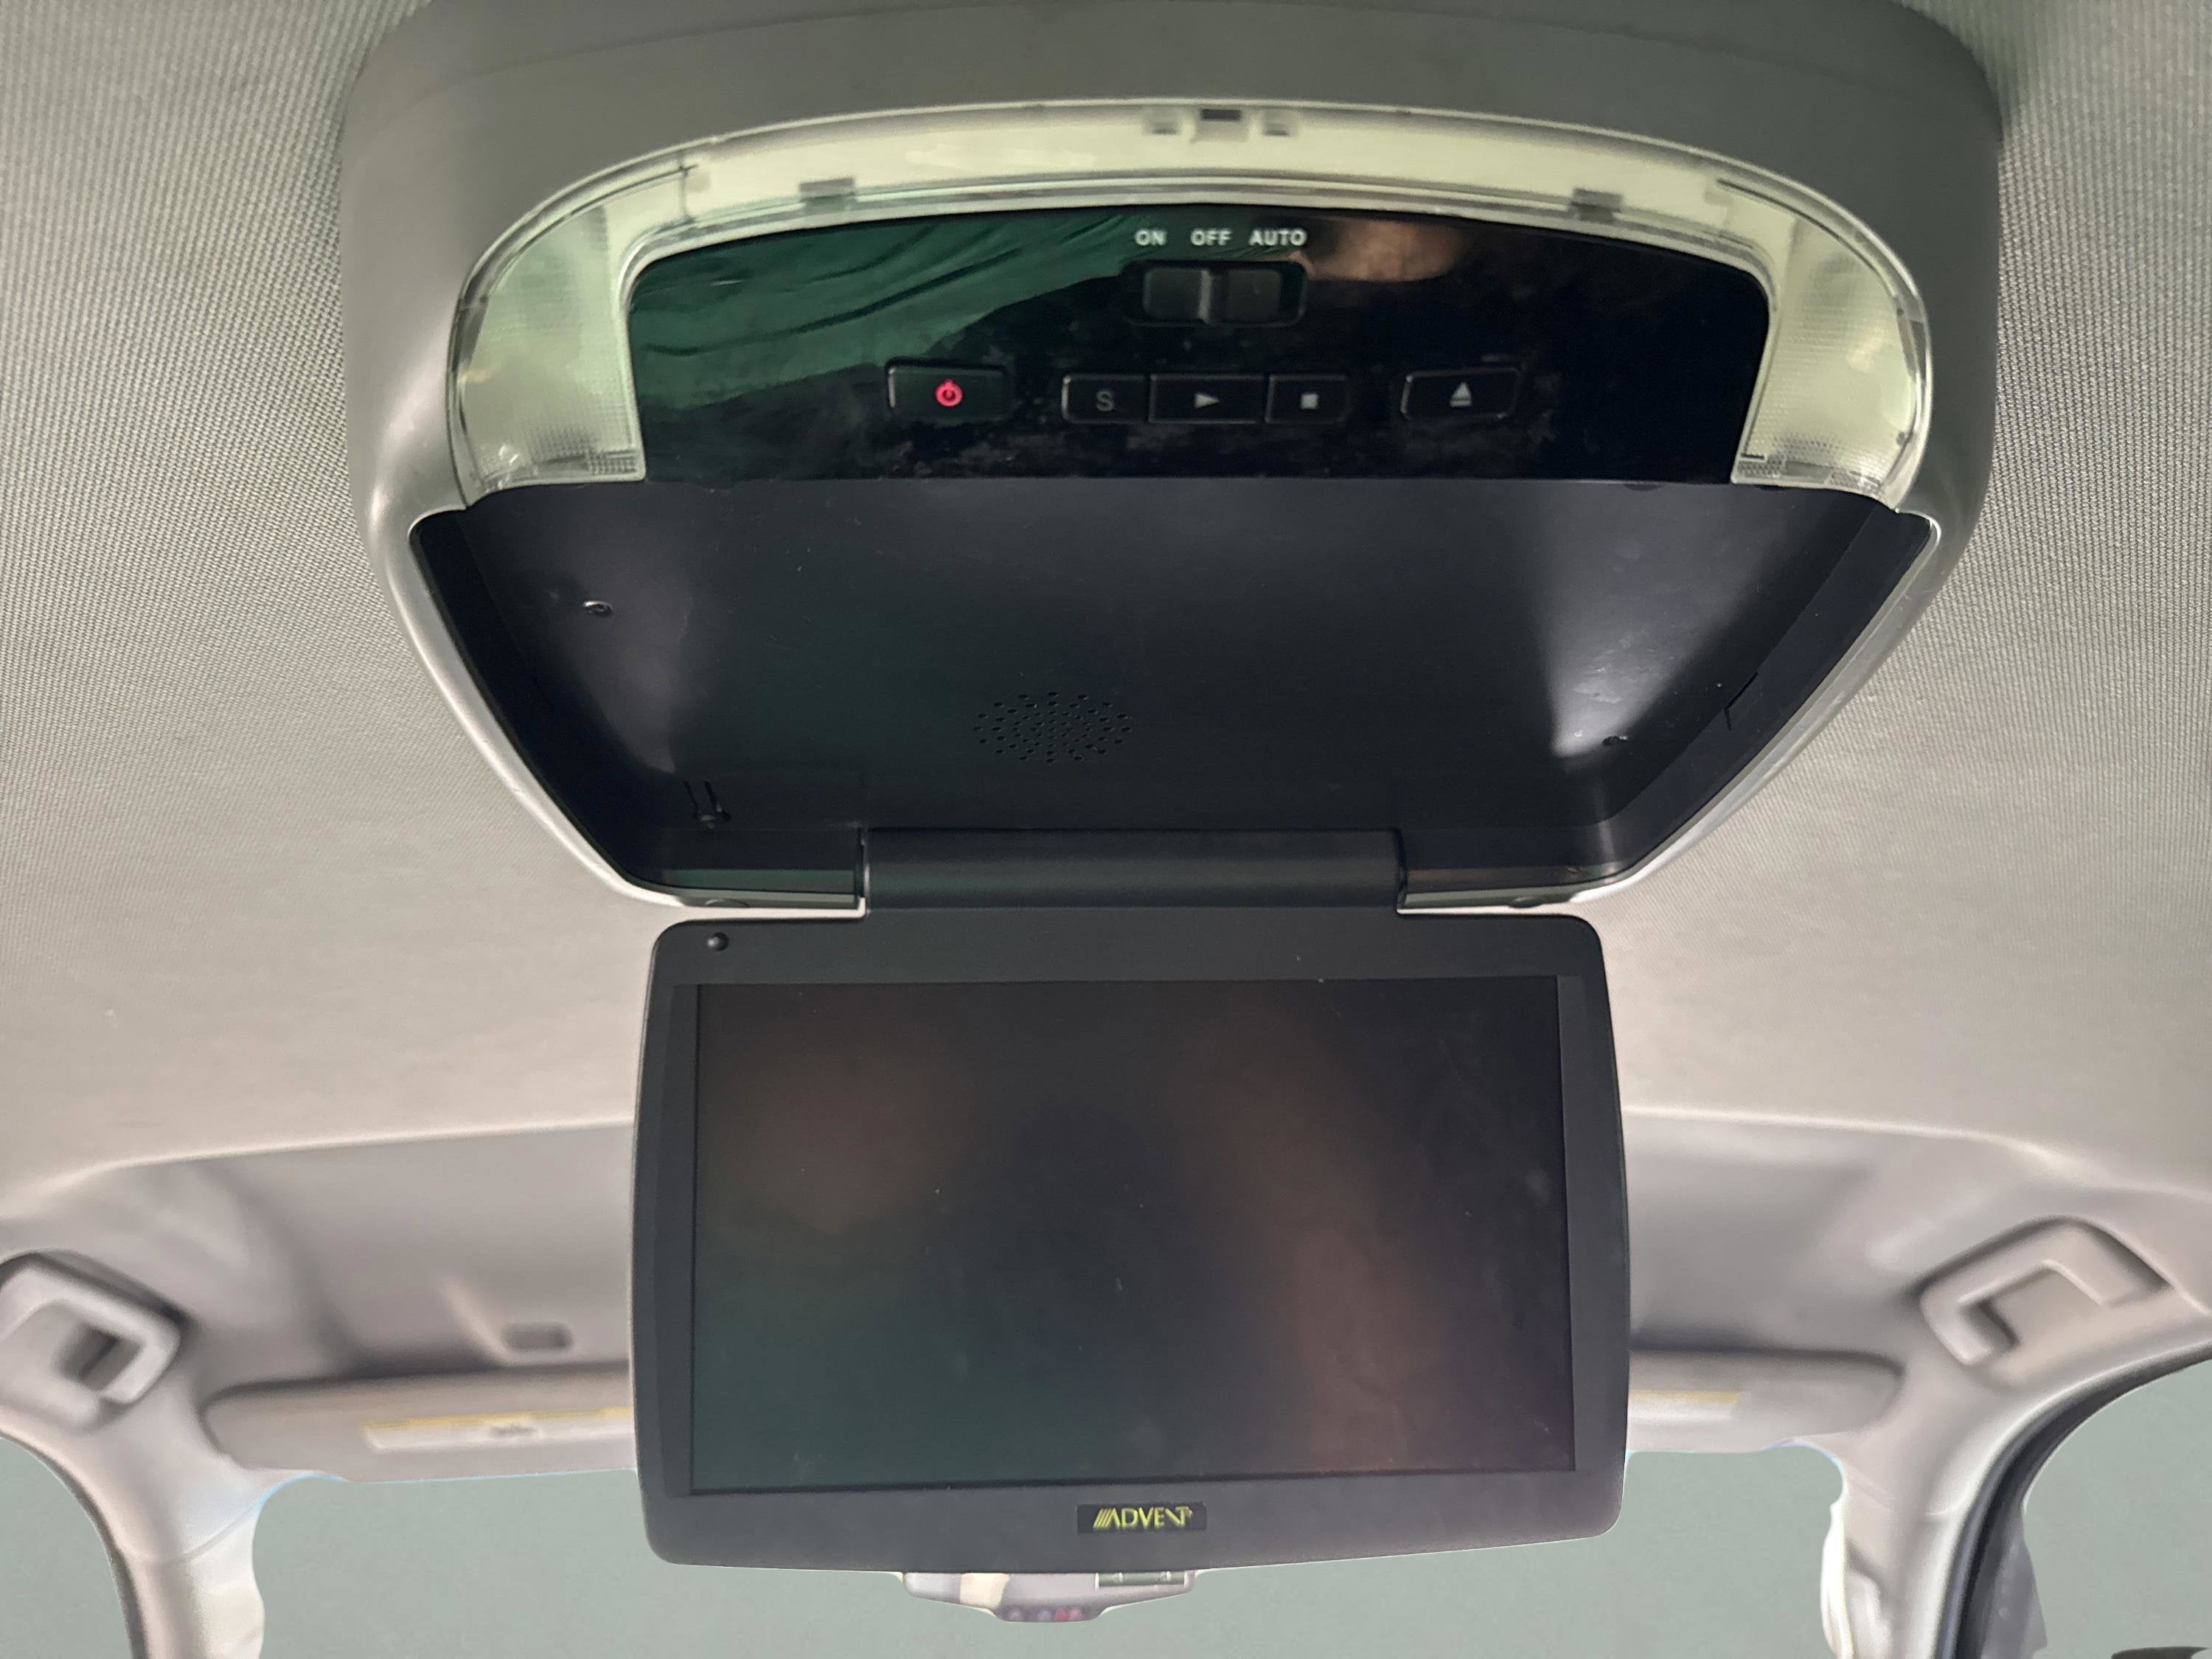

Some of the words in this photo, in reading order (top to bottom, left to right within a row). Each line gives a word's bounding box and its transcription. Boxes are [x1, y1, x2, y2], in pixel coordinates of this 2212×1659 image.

[1134, 229, 1167, 246] ON
[1190, 229, 1232, 246] OFF
[1249, 229, 1307, 246] AUTO
[1096, 390, 1115, 411] S
